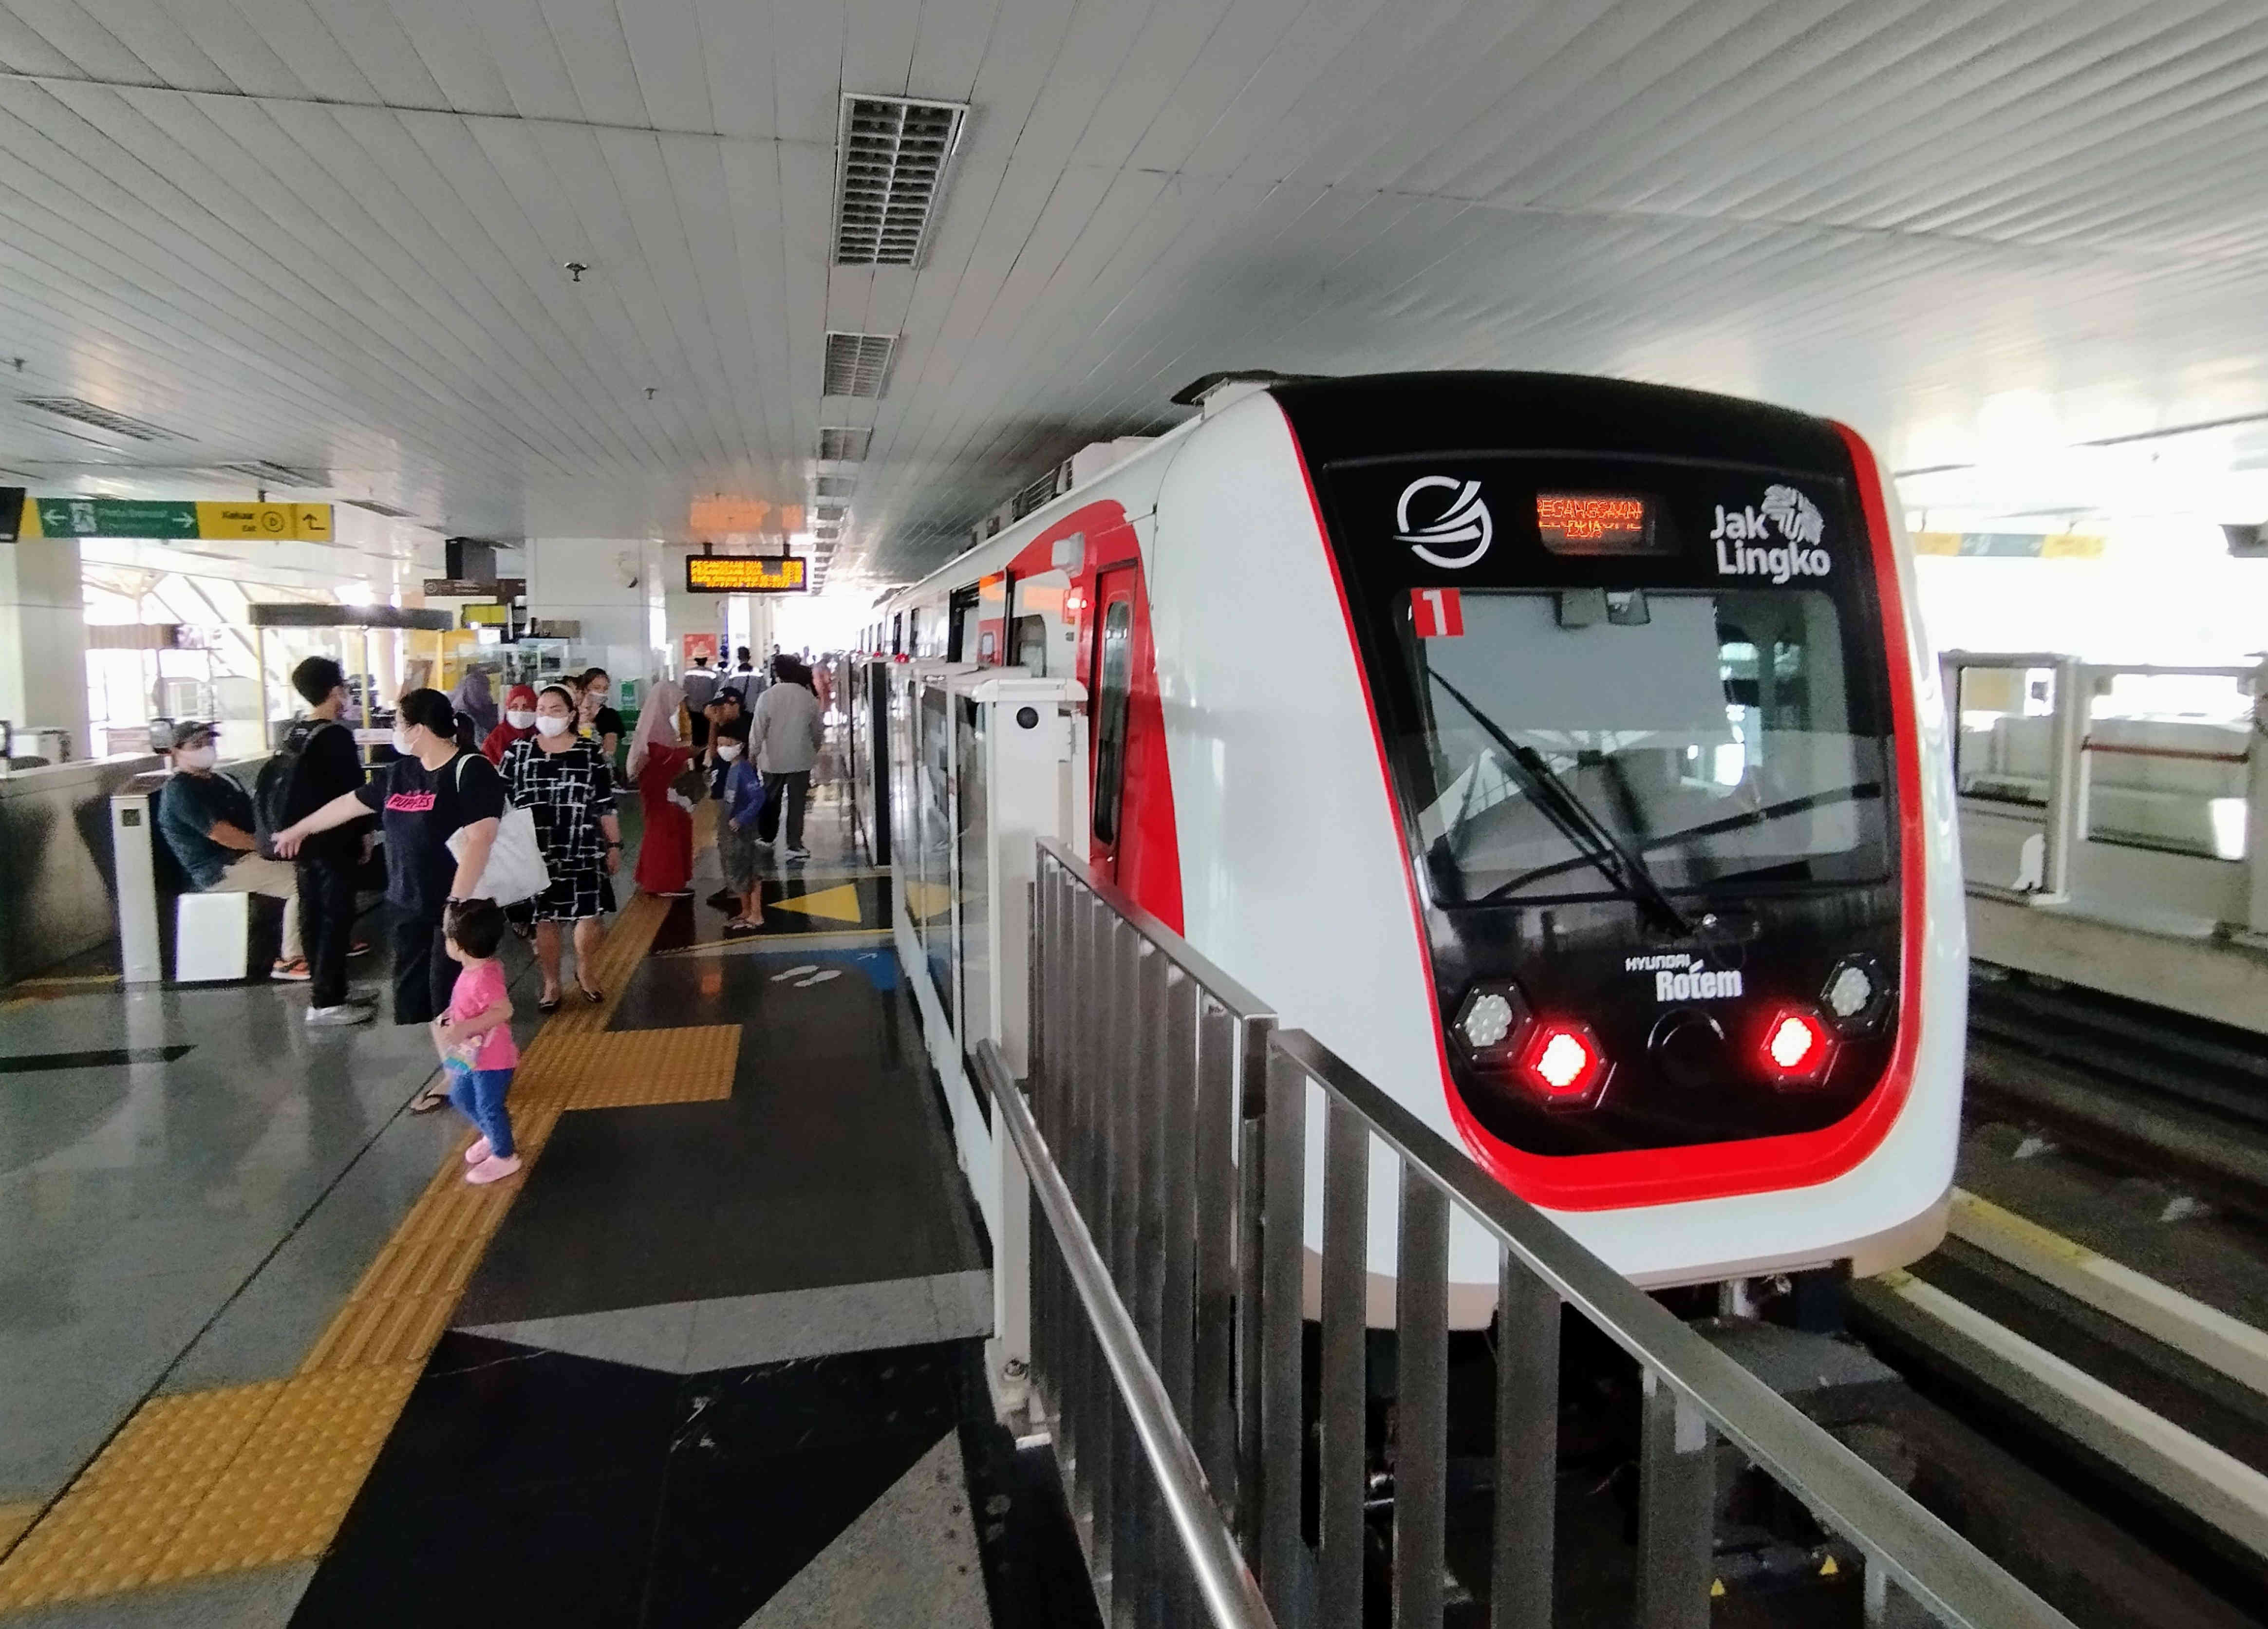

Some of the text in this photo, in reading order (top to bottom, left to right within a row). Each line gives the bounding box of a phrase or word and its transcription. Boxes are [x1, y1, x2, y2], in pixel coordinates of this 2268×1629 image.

[1710, 505, 1769, 540] Jak
[1716, 539, 1831, 584] Lingko
[1422, 590, 1448, 635] 1
[1625, 954, 1690, 972] HYUNDAI
[1656, 959, 1743, 1002] Rotem
